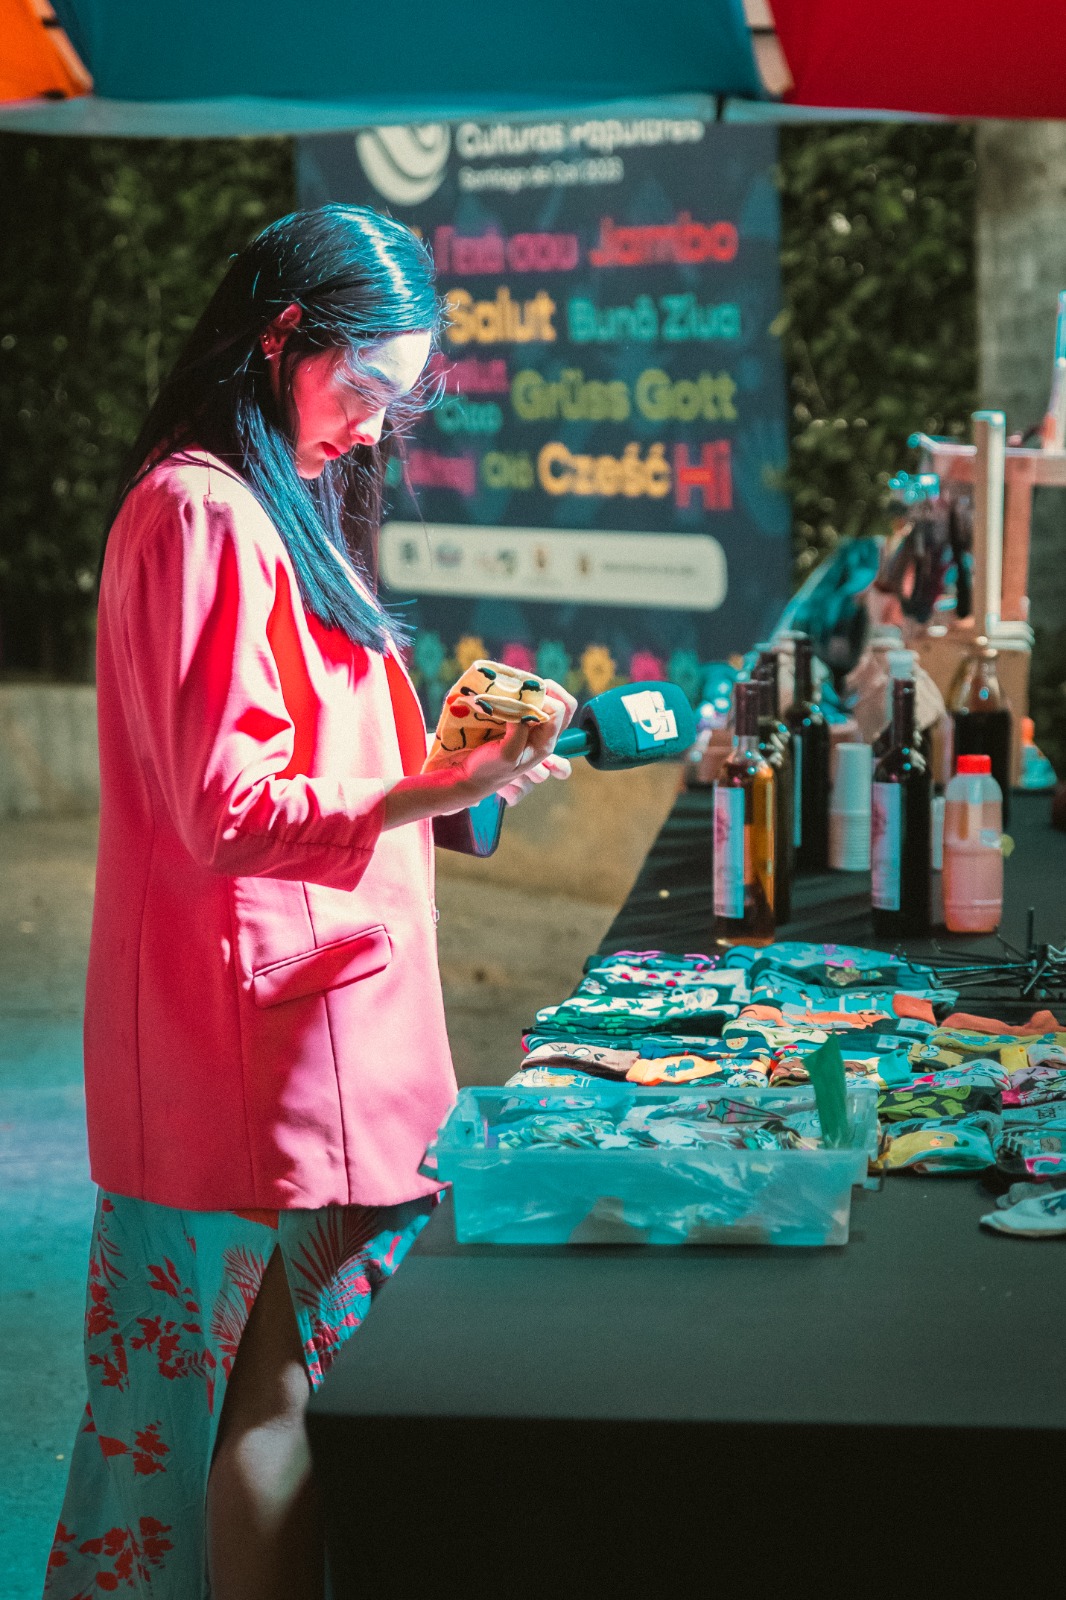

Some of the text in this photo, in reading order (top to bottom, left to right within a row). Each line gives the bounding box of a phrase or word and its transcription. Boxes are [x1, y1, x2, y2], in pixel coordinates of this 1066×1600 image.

[456, 122, 565, 157] Culturas
[590, 212, 738, 266] Jambo
[446, 287, 556, 343] Salut
[660, 292, 742, 342] Ziua
[512, 368, 629, 421] Grüss
[635, 368, 738, 421] Gott
[673, 441, 733, 511] Hi
